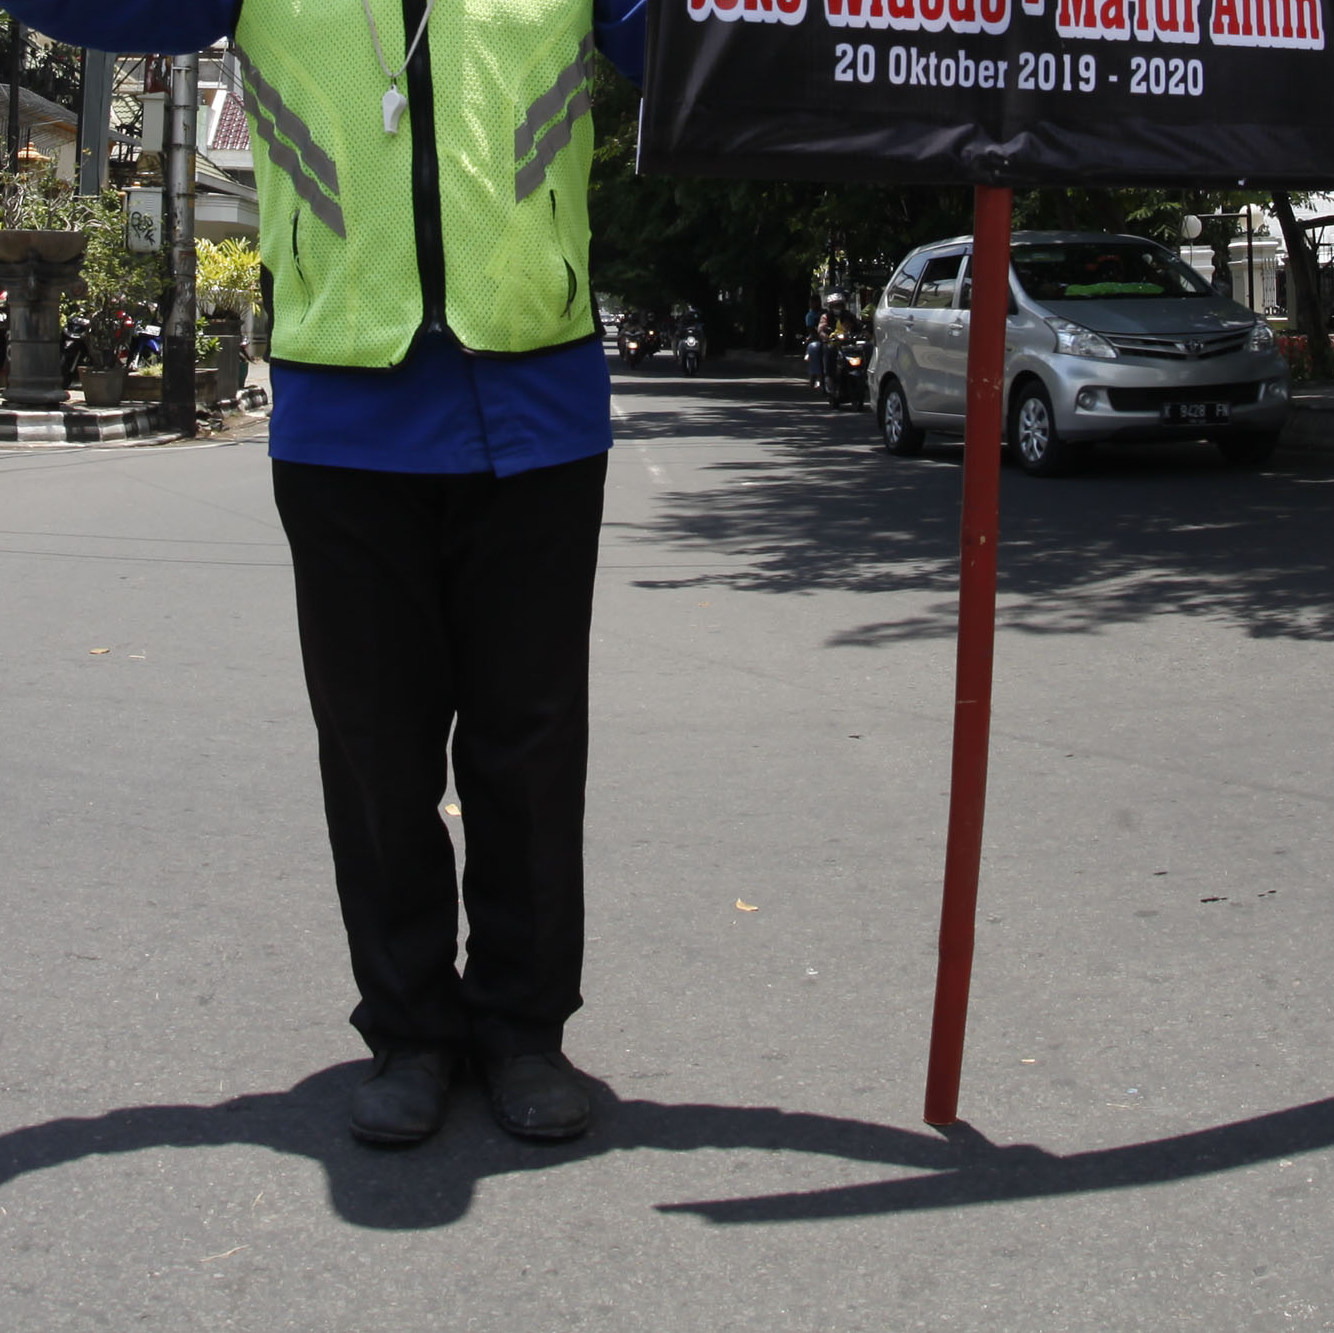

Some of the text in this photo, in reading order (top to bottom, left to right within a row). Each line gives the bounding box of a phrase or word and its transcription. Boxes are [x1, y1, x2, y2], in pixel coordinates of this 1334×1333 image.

[834, 44, 876, 83] 20
[889, 46, 1008, 89] Oktober
[1018, 52, 1096, 92] 2019
[1130, 57, 1204, 96] 2020
